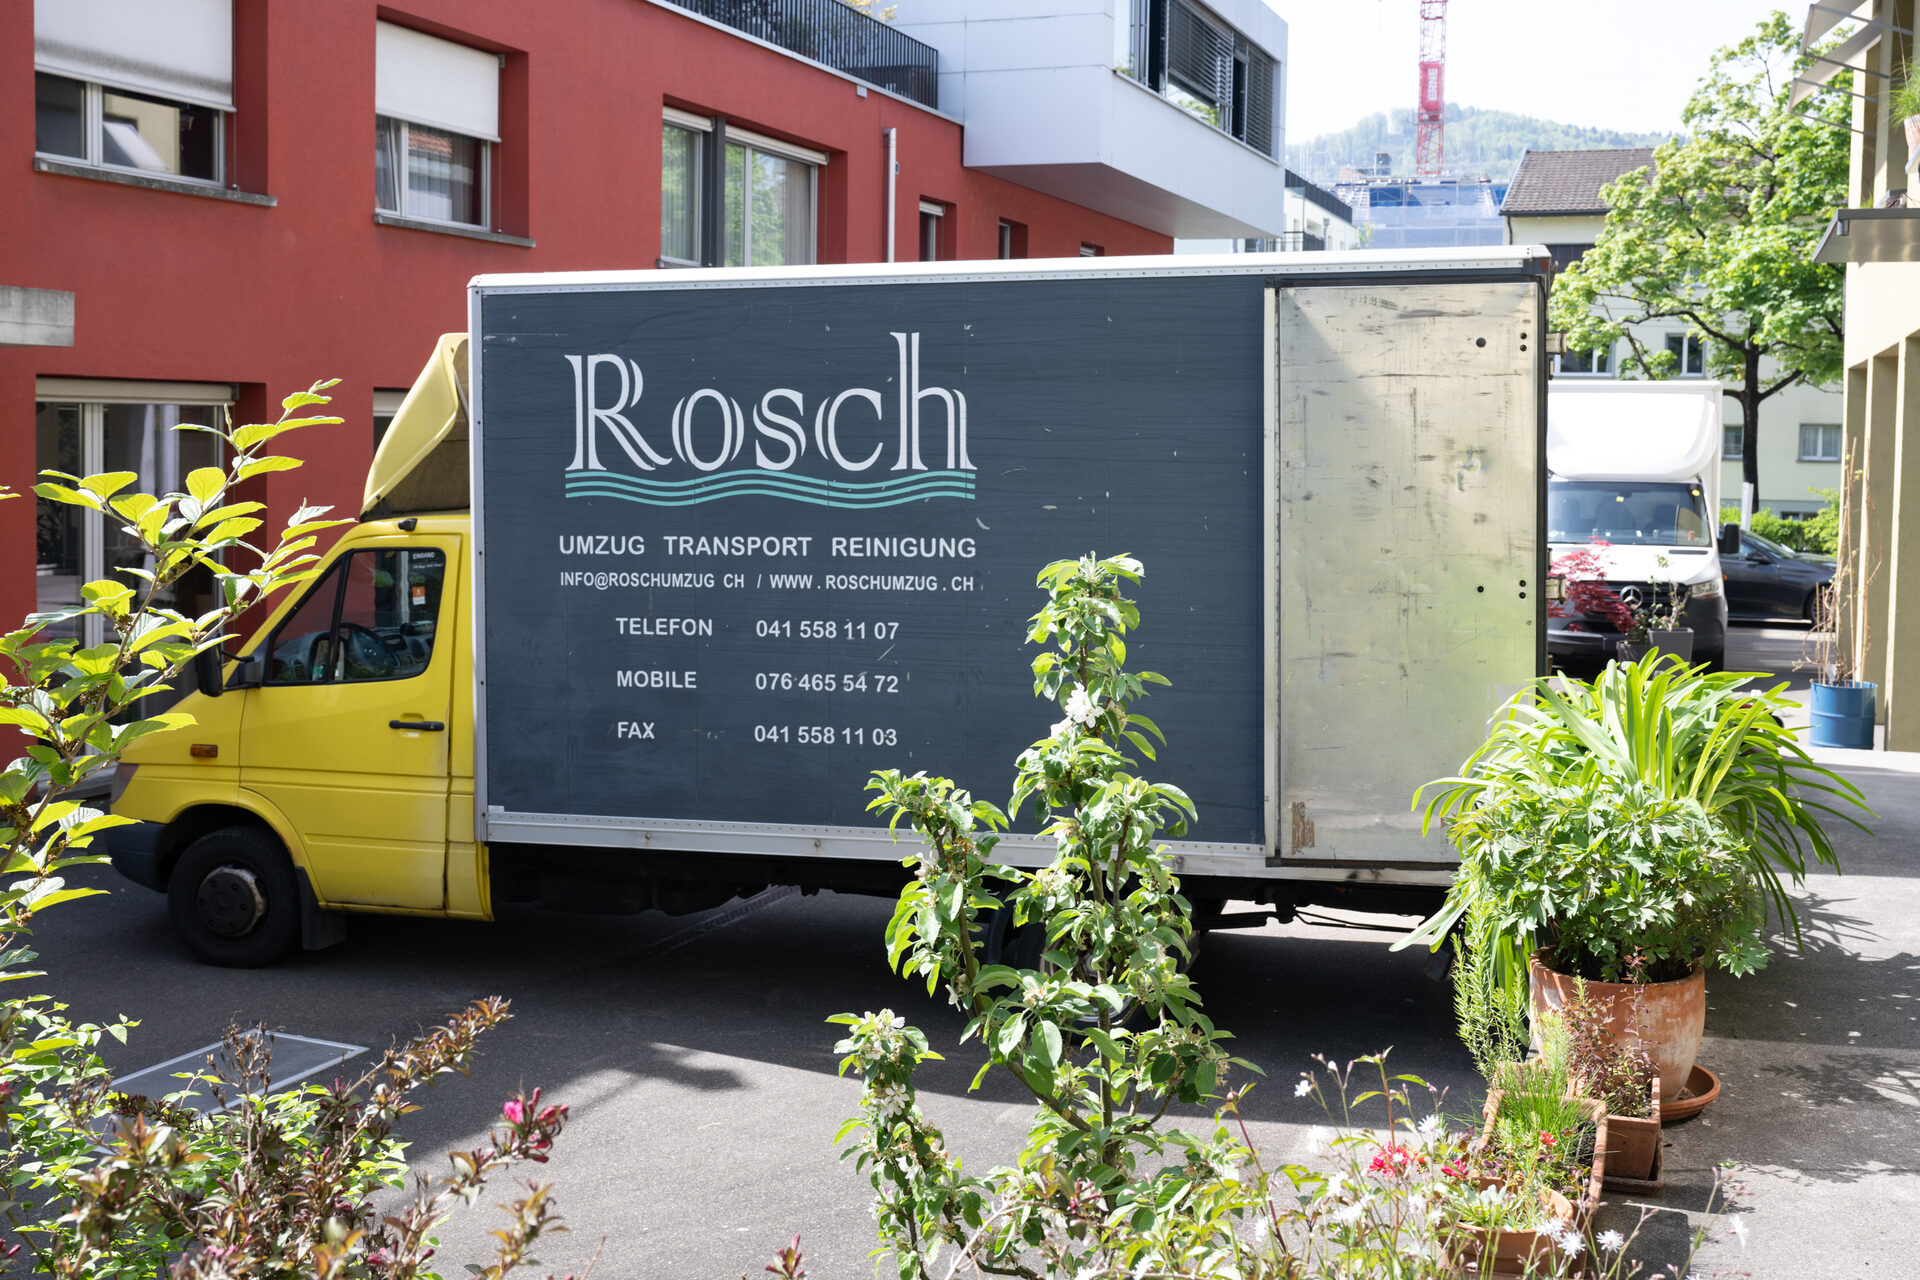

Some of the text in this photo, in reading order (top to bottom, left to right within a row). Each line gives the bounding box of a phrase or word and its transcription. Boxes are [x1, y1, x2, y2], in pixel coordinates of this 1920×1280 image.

[564, 332, 978, 471] Rosch
[559, 535, 977, 559] UMZUG TRANSPORT REINIGUNG
[560, 571, 715, 590] INFO@ROSCHUMZUG
[723, 573, 745, 588] CH
[615, 617, 713, 636] TELEFON
[756, 620, 899, 640] 041 558 11 07
[617, 671, 697, 688] MOBILE
[755, 673, 899, 693] 076 465 54 72
[617, 721, 655, 739] FAX
[754, 725, 898, 746] 041 558 11 03
